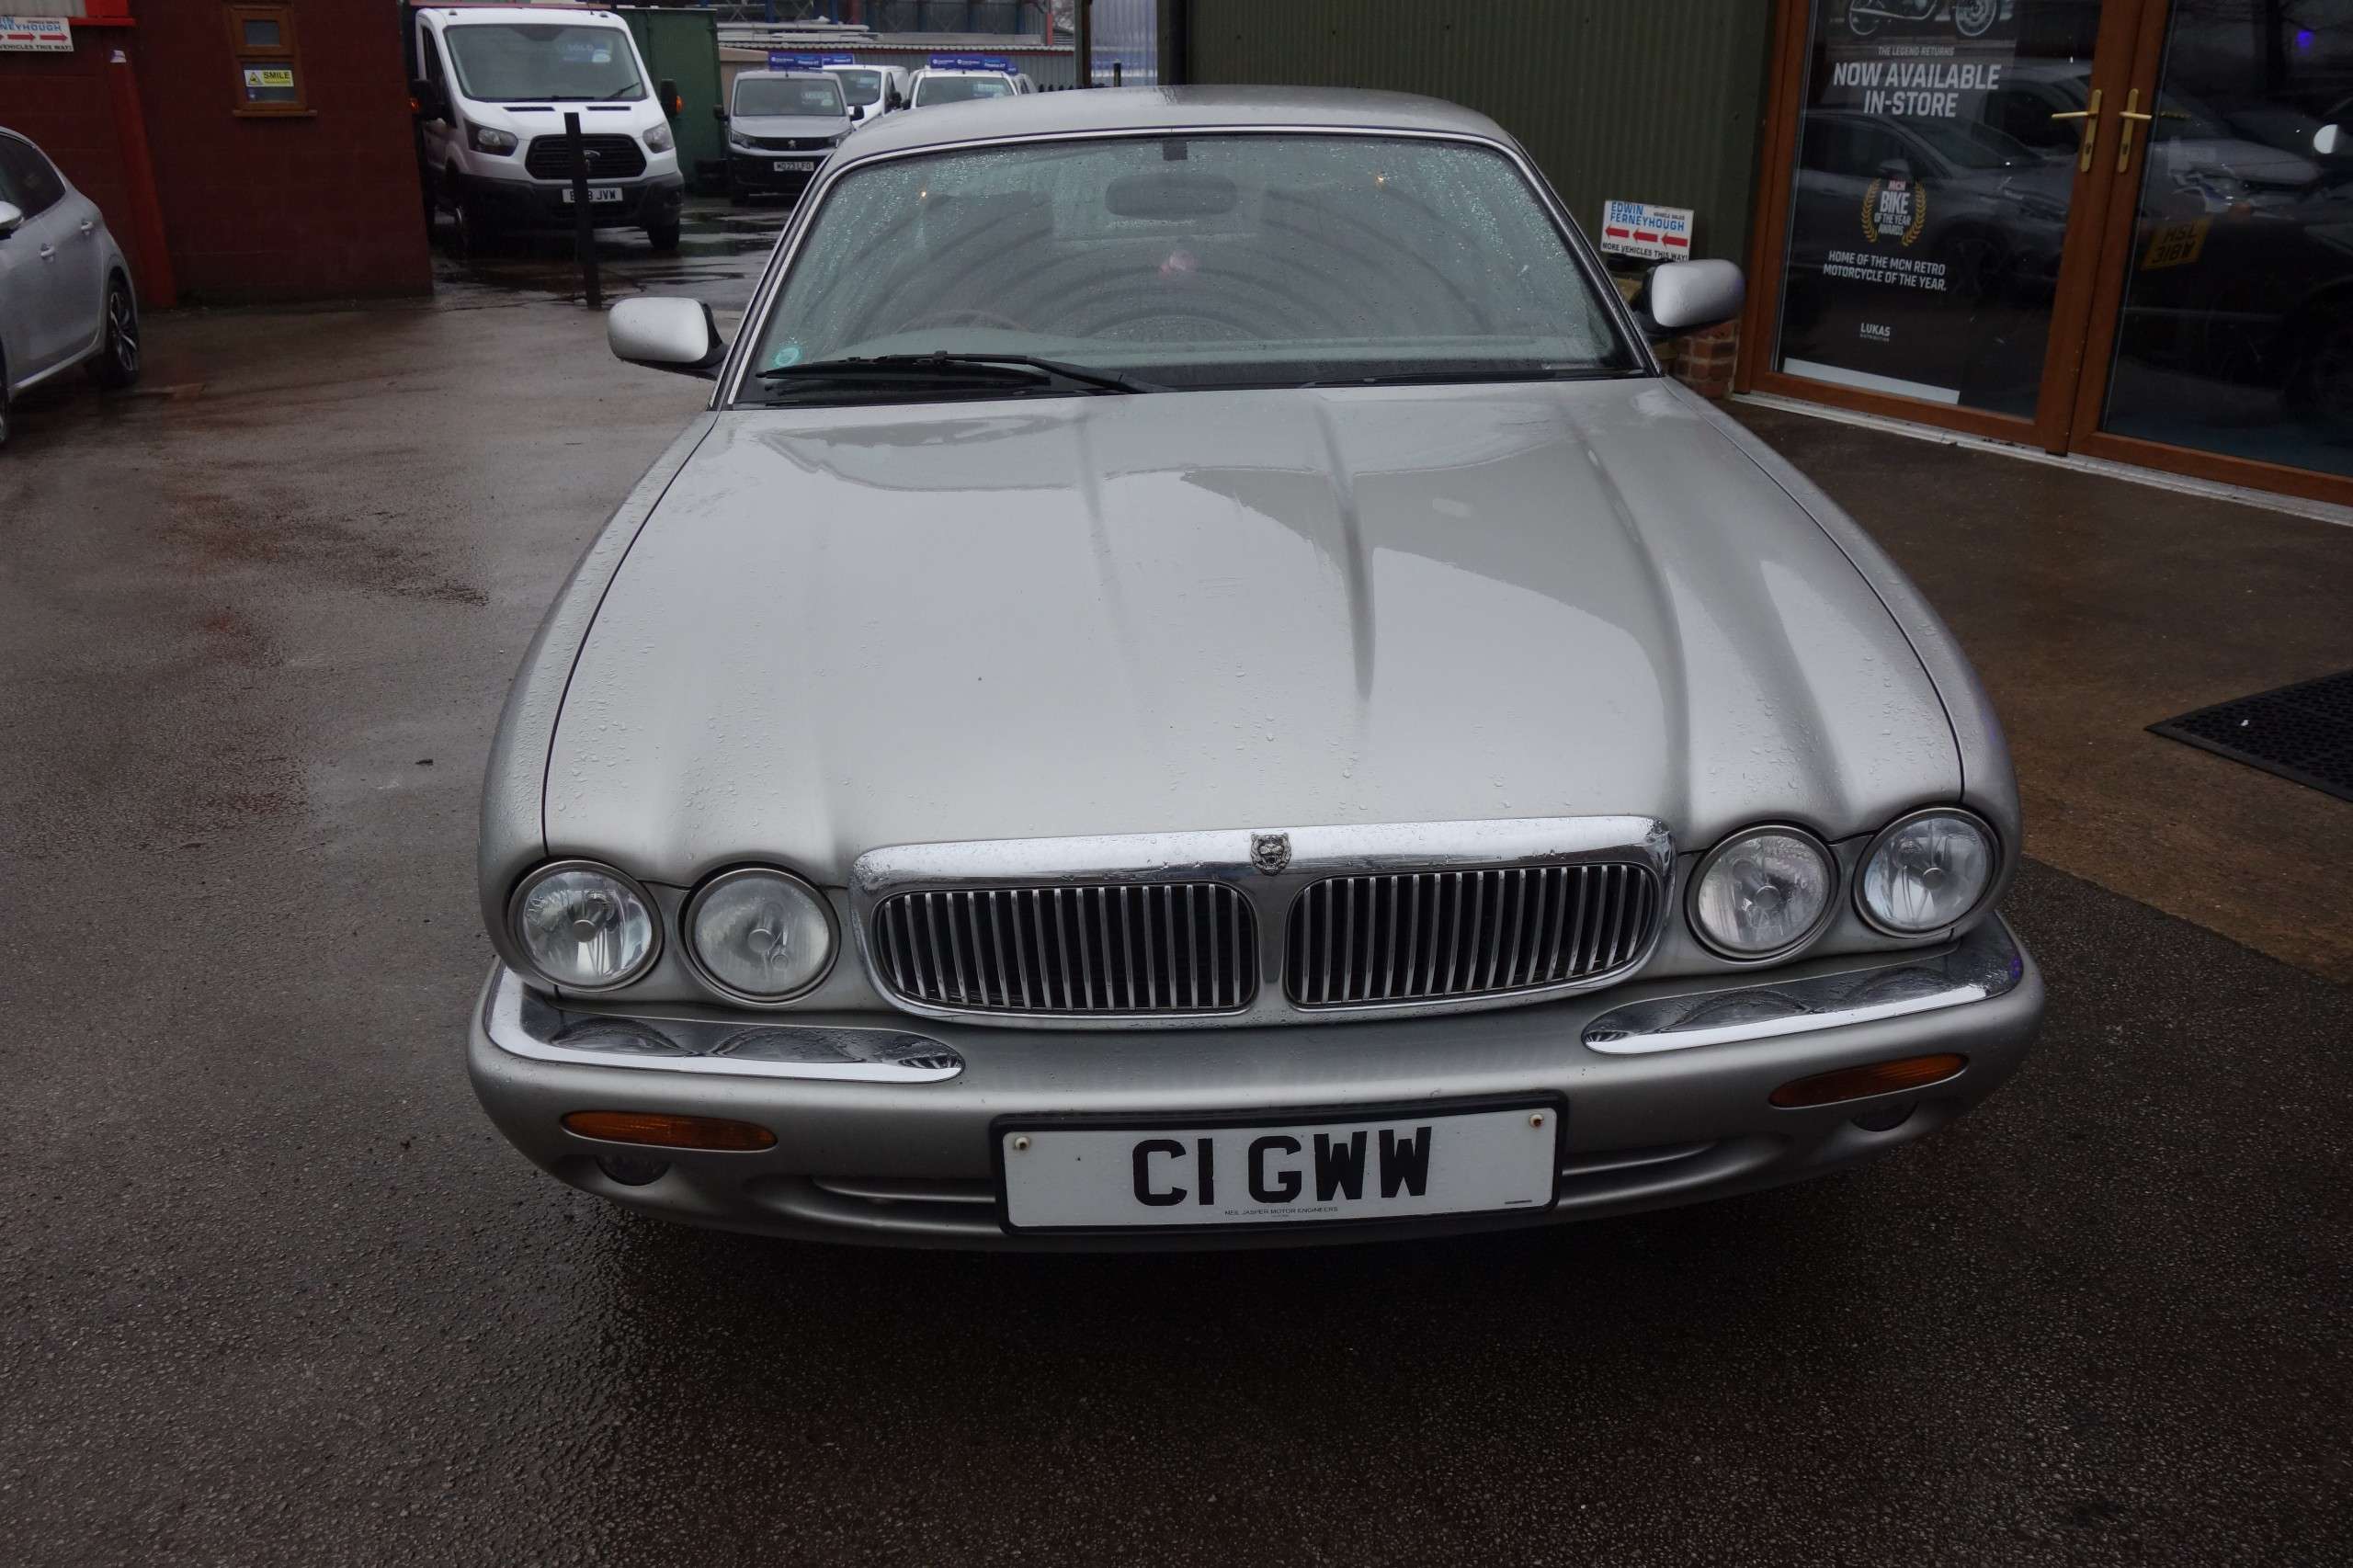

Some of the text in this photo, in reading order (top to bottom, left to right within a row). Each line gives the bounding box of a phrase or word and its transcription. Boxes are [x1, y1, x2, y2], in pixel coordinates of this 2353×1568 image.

[1878, 46, 1955, 57] THE LEGEND RETURNS
[1833, 62, 2002, 90] NOW AVAILABLE
[1863, 90, 1959, 118] IN-STORE
[1611, 201, 1643, 215] EDWIN
[1880, 190, 1911, 214] BIKE
[1610, 212, 1685, 232] FERNEYHOUGH
[1874, 212, 1912, 226] OF THE YEAR
[1878, 224, 1904, 236] AWARDS
[1602, 242, 1688, 262] MORE VEHICLES THIS WAY!
[1828, 250, 1946, 276] HOME OF THE MCN RETRO
[1823, 264, 1947, 291] MOTORCYCLE OF THE YEAR.
[1860, 323, 1891, 336] LUKAS
[1247, 1126, 1433, 1204] GWW
[1297, 1206, 1338, 1214] ENGINEERS
